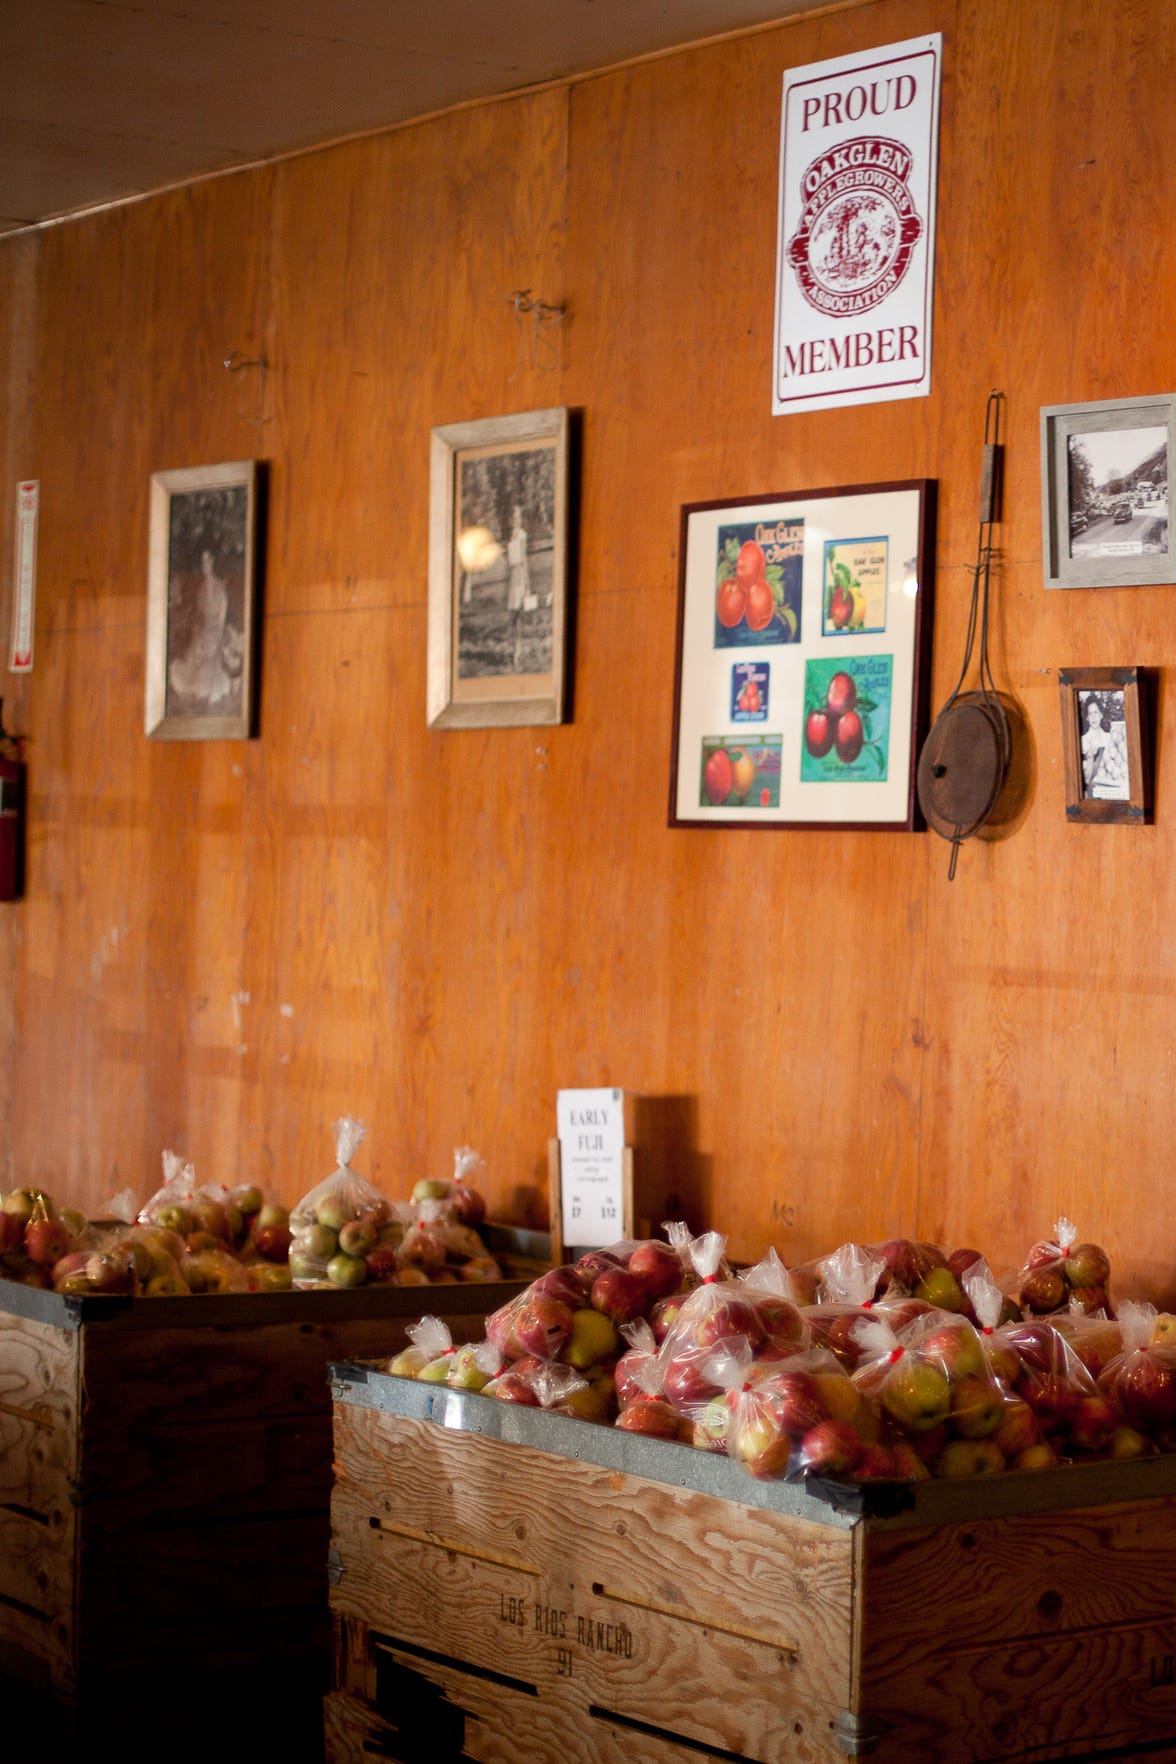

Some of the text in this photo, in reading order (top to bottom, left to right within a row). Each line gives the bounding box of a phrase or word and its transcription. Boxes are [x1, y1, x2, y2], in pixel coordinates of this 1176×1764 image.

[801, 74, 917, 132] PROUD
[808, 269, 897, 311] ASSOCIATION
[783, 325, 920, 378] MEMBER
[570, 1109, 609, 1127] EARLY
[578, 1134, 604, 1151] FUJI
[501, 1593, 632, 1659] LOS RIOS RANCHO
